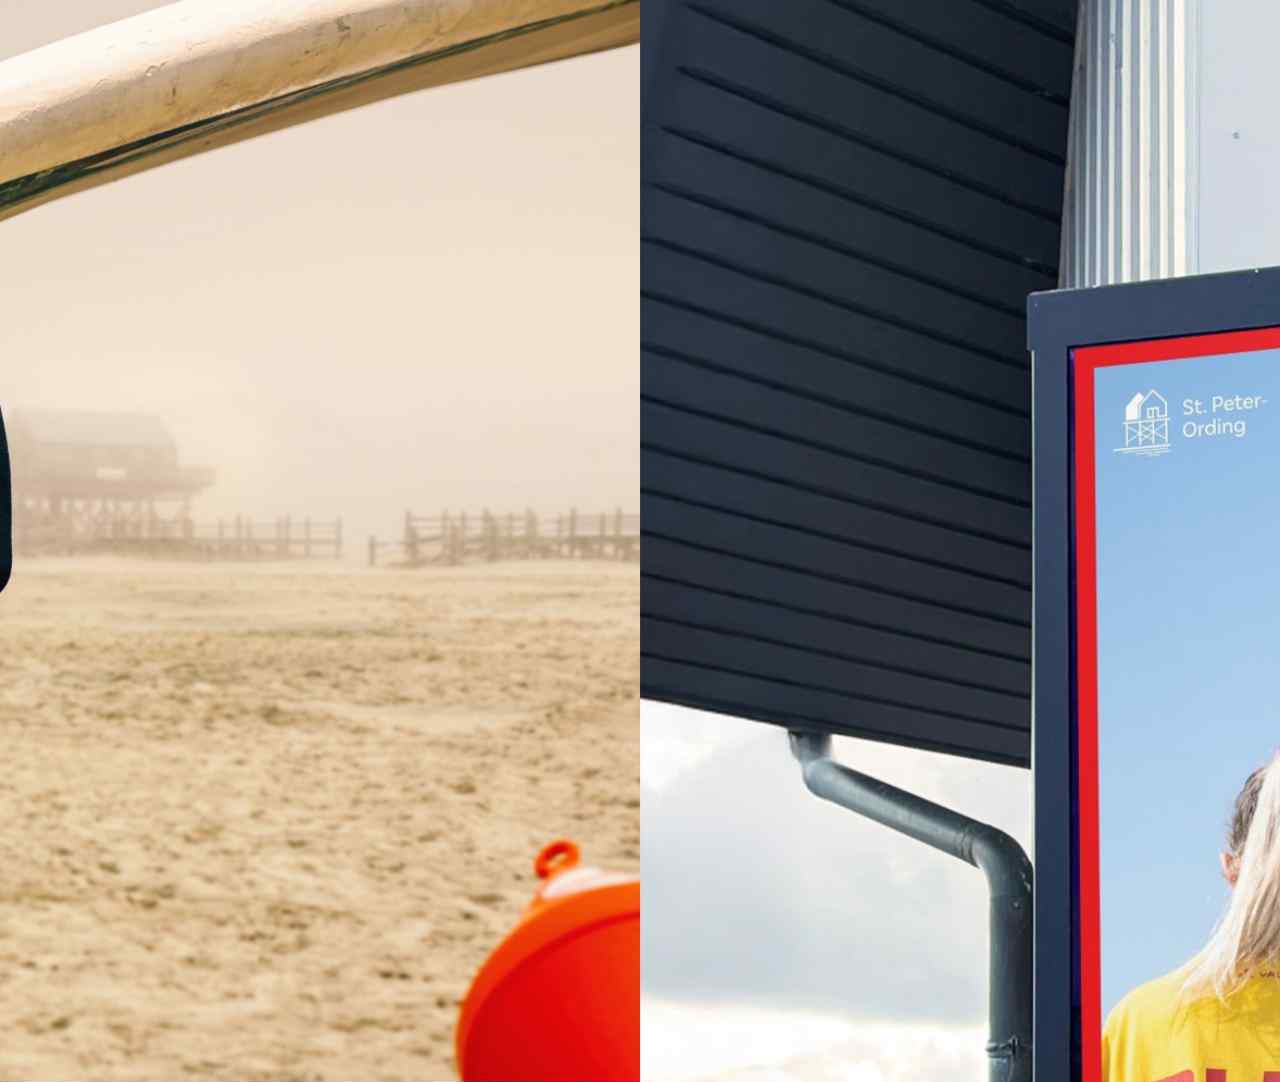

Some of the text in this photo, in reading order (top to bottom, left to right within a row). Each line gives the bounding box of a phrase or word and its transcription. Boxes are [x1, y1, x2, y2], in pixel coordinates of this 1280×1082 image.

[1182, 394, 1268, 415] St. Peter-
[1182, 418, 1246, 438] Ording
